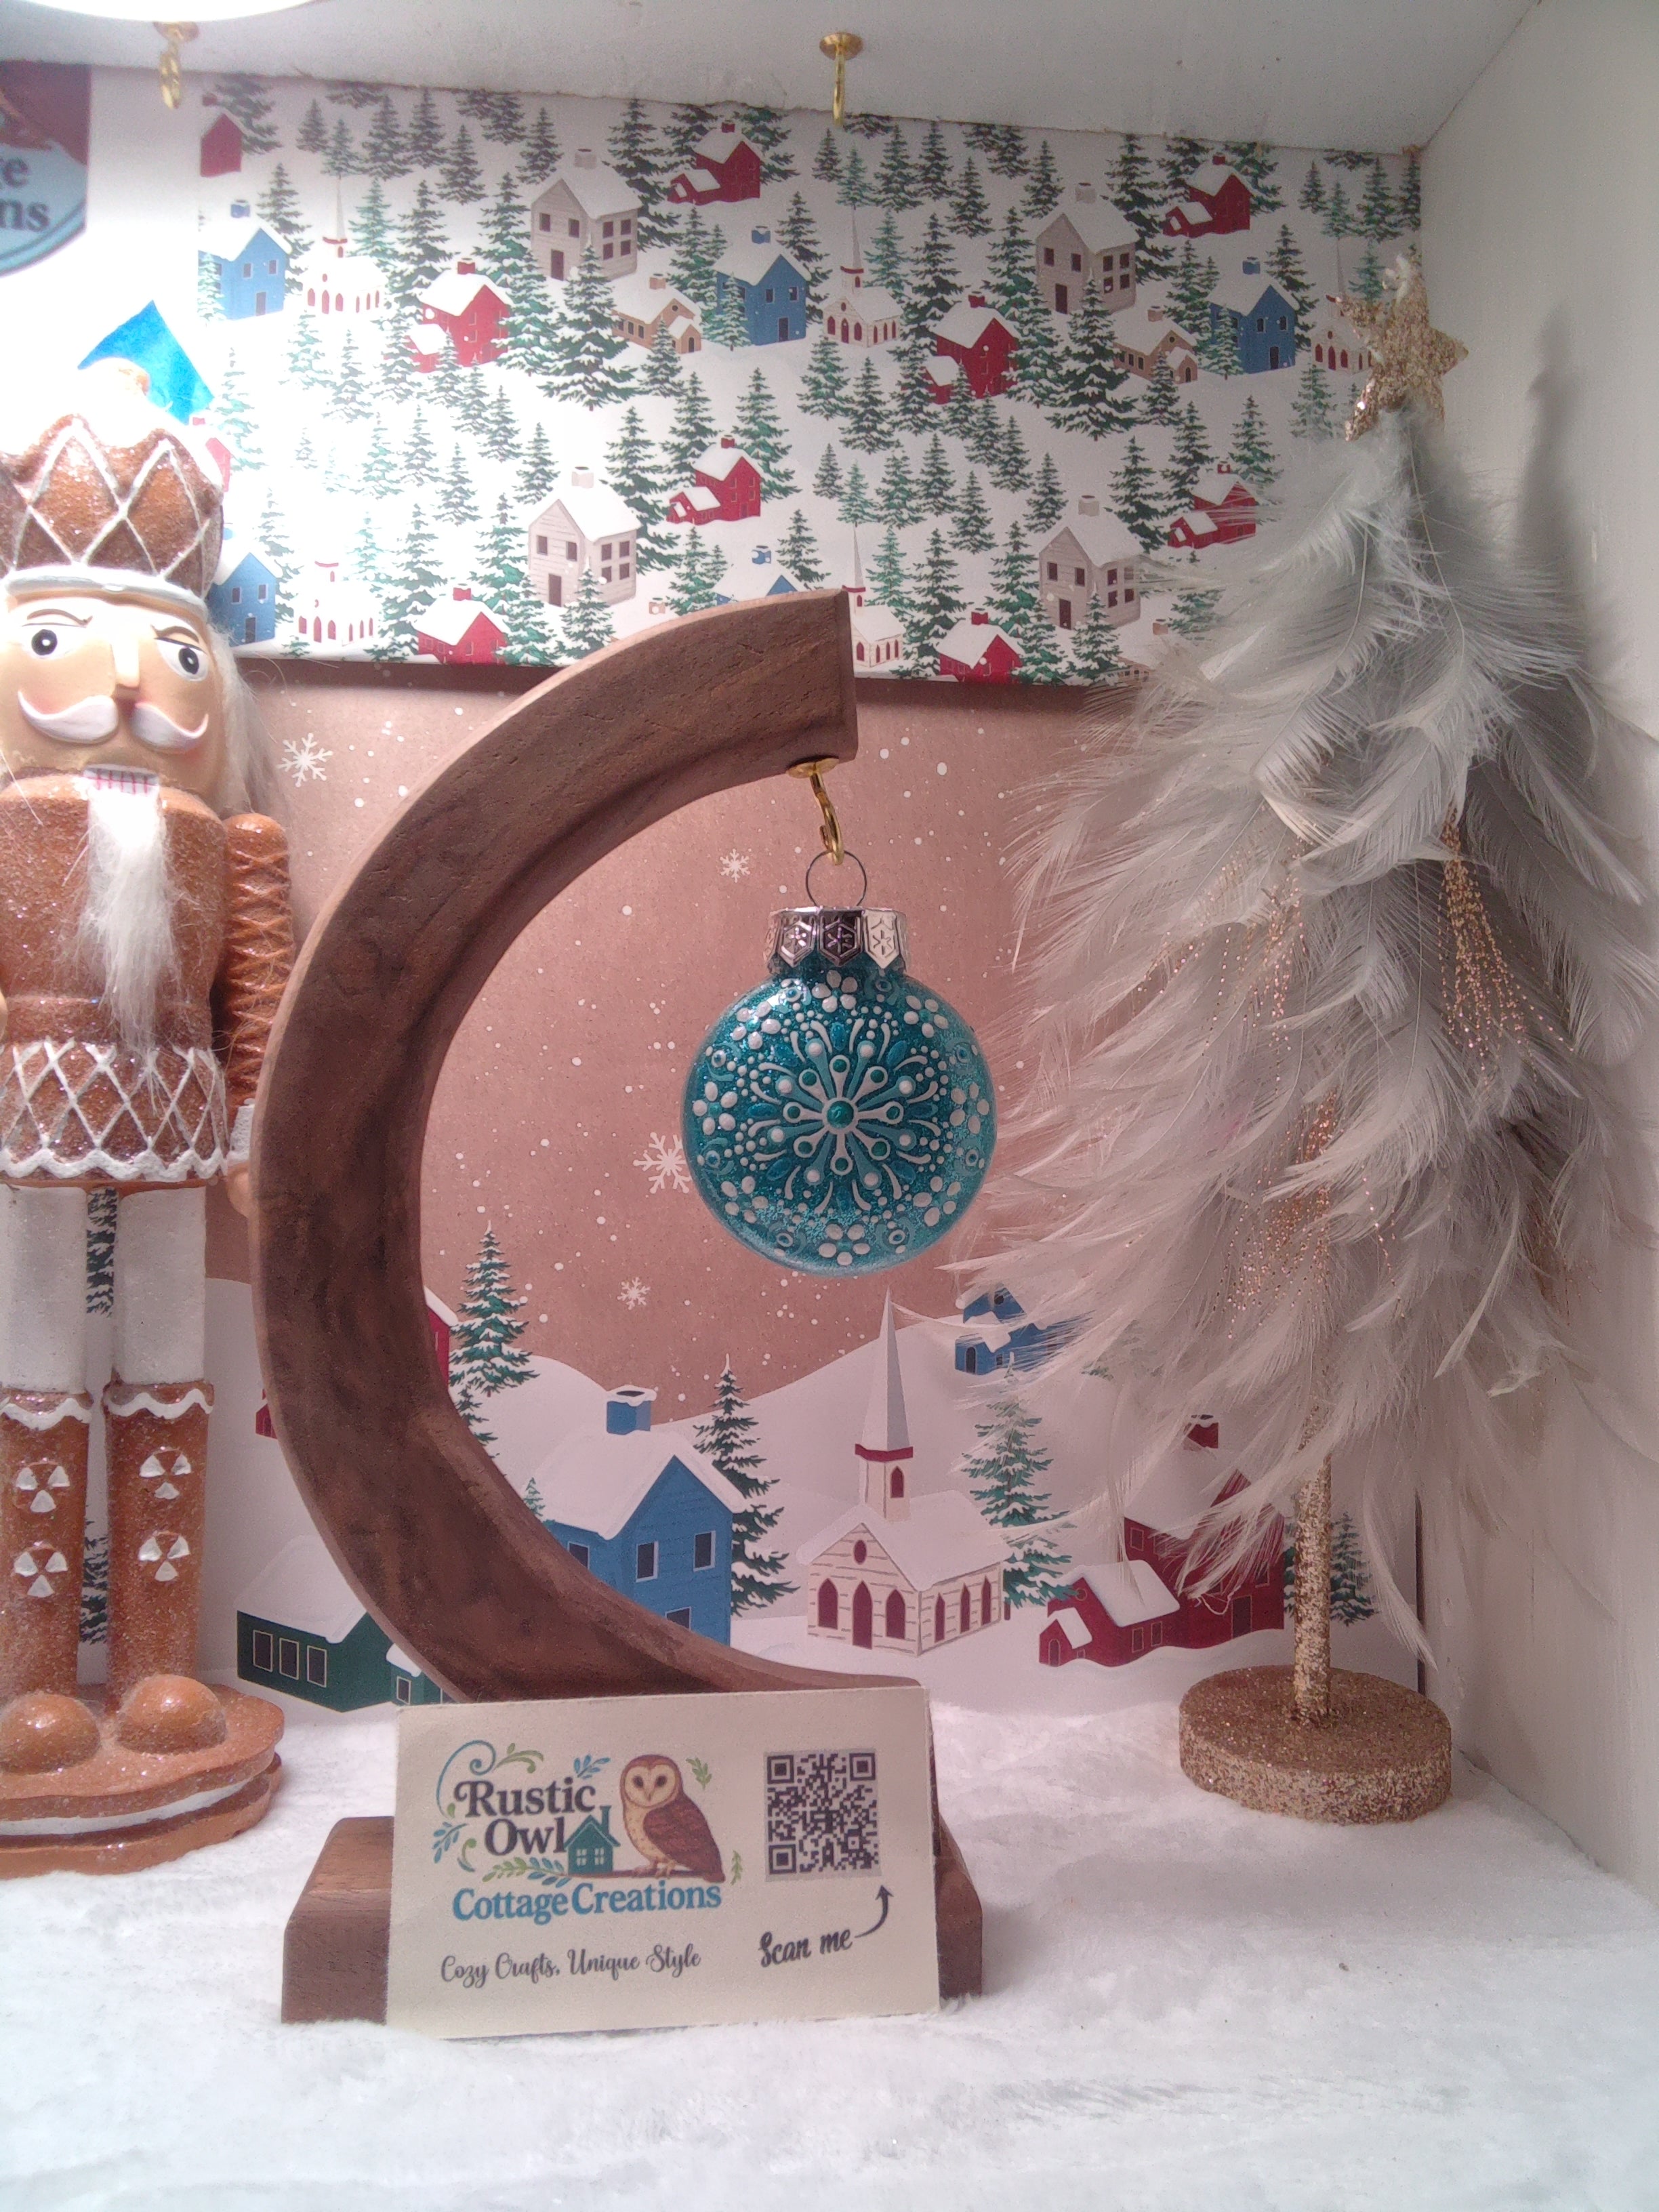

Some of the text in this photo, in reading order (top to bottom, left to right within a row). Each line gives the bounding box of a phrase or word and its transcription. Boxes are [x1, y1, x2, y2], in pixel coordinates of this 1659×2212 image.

[453, 1776, 596, 1818] Rustic
[484, 1816, 566, 1856] Owl
[452, 1879, 722, 1925] Cottage Creations
[441, 1942, 701, 1989] Cozy Crafts, Unique Style
[758, 1929, 853, 1968] Scan me
